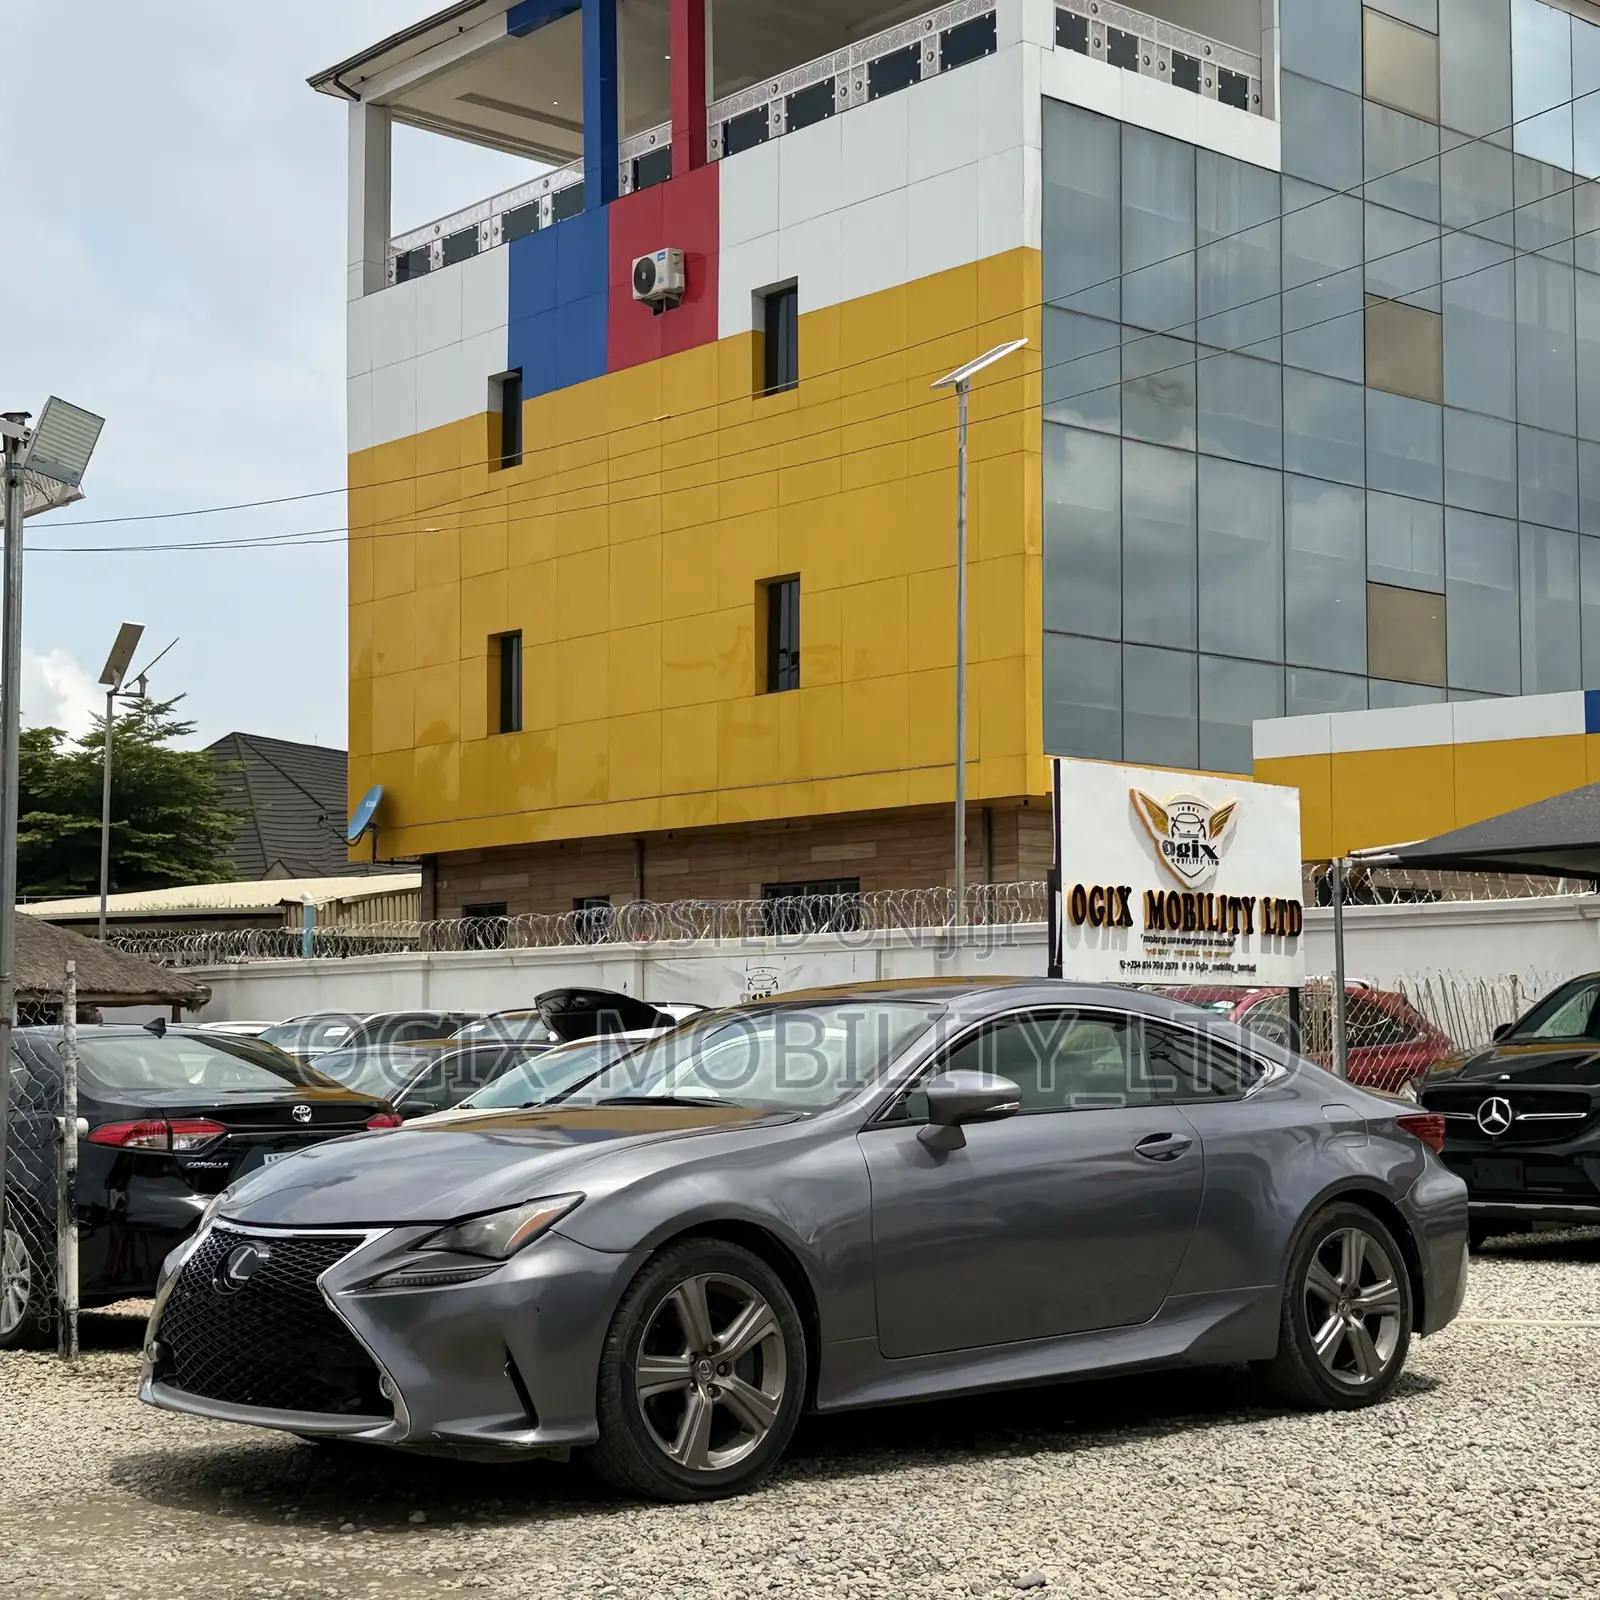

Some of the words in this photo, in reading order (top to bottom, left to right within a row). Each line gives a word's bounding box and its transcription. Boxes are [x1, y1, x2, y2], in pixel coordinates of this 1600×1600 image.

[1067, 883, 1134, 928] OGIX
[1143, 889, 1256, 935] MOBILITY
[1260, 896, 1302, 937] LTD
[186, 1161, 229, 1169] COROLLA
